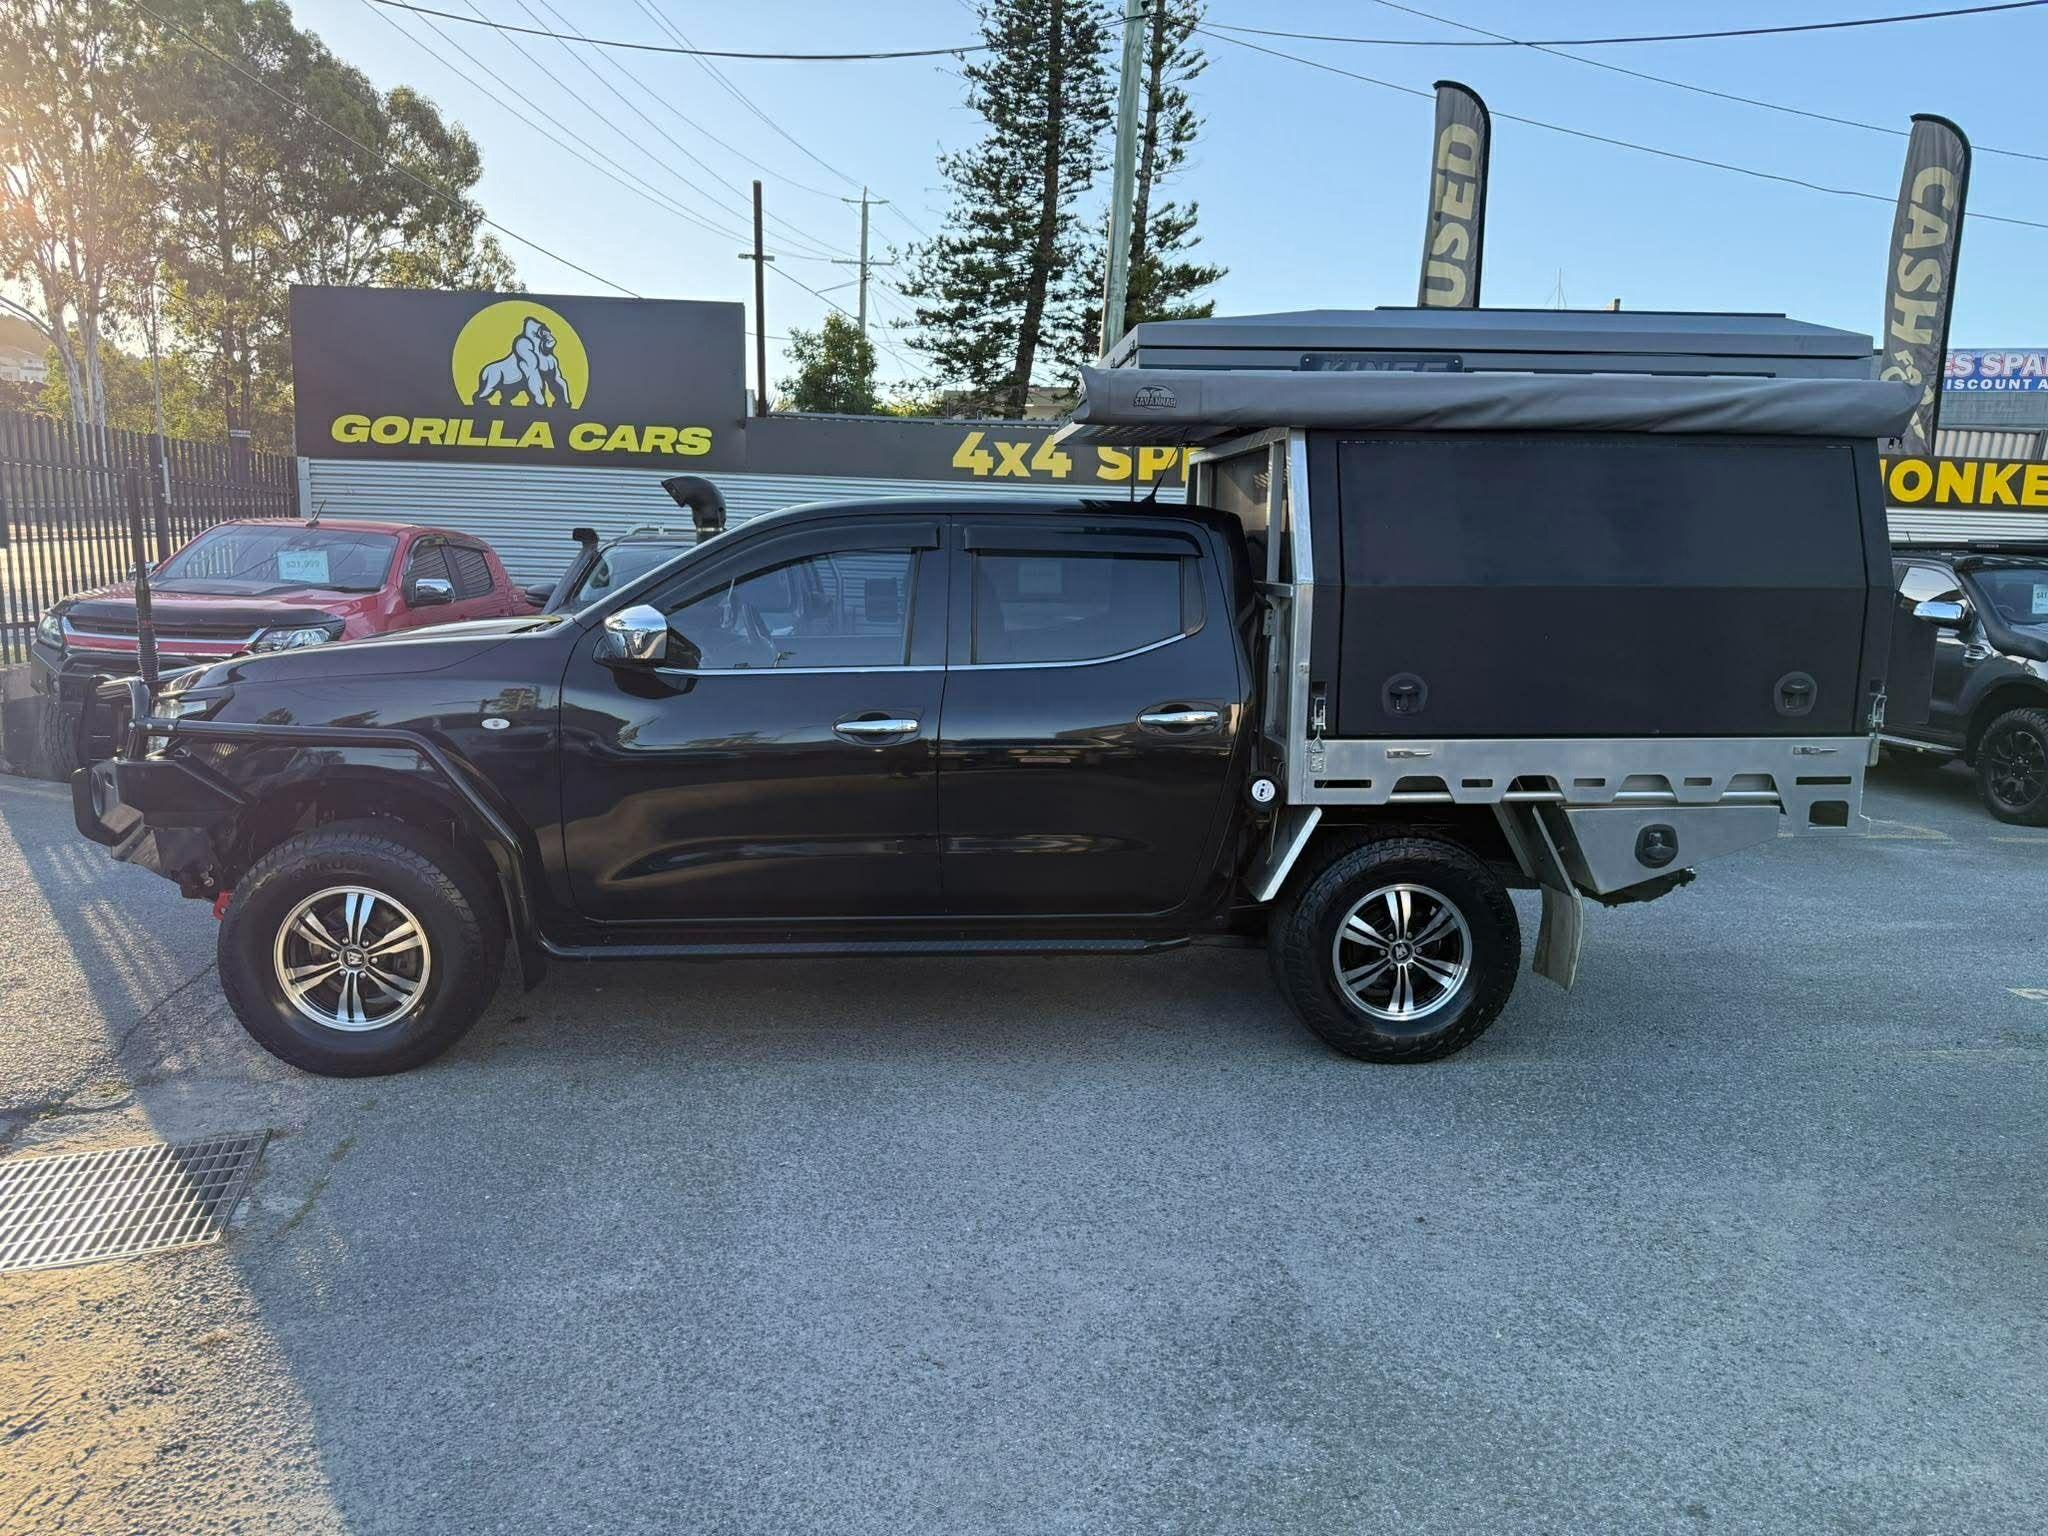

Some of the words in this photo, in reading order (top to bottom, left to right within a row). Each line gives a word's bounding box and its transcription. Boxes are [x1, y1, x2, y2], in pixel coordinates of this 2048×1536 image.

[1425, 123, 1479, 306] USED
[1891, 166, 1955, 344] CASH
[1944, 378, 2033, 390] ISCOUNT
[1979, 351, 2048, 378] SPA
[1134, 396, 1177, 408] SAVANNAH
[331, 414, 555, 449] GORILLA
[568, 423, 712, 455] CARS
[953, 432, 1072, 478] 4x4
[1096, 447, 1202, 480] SP
[1880, 459, 2048, 506] ONKE
